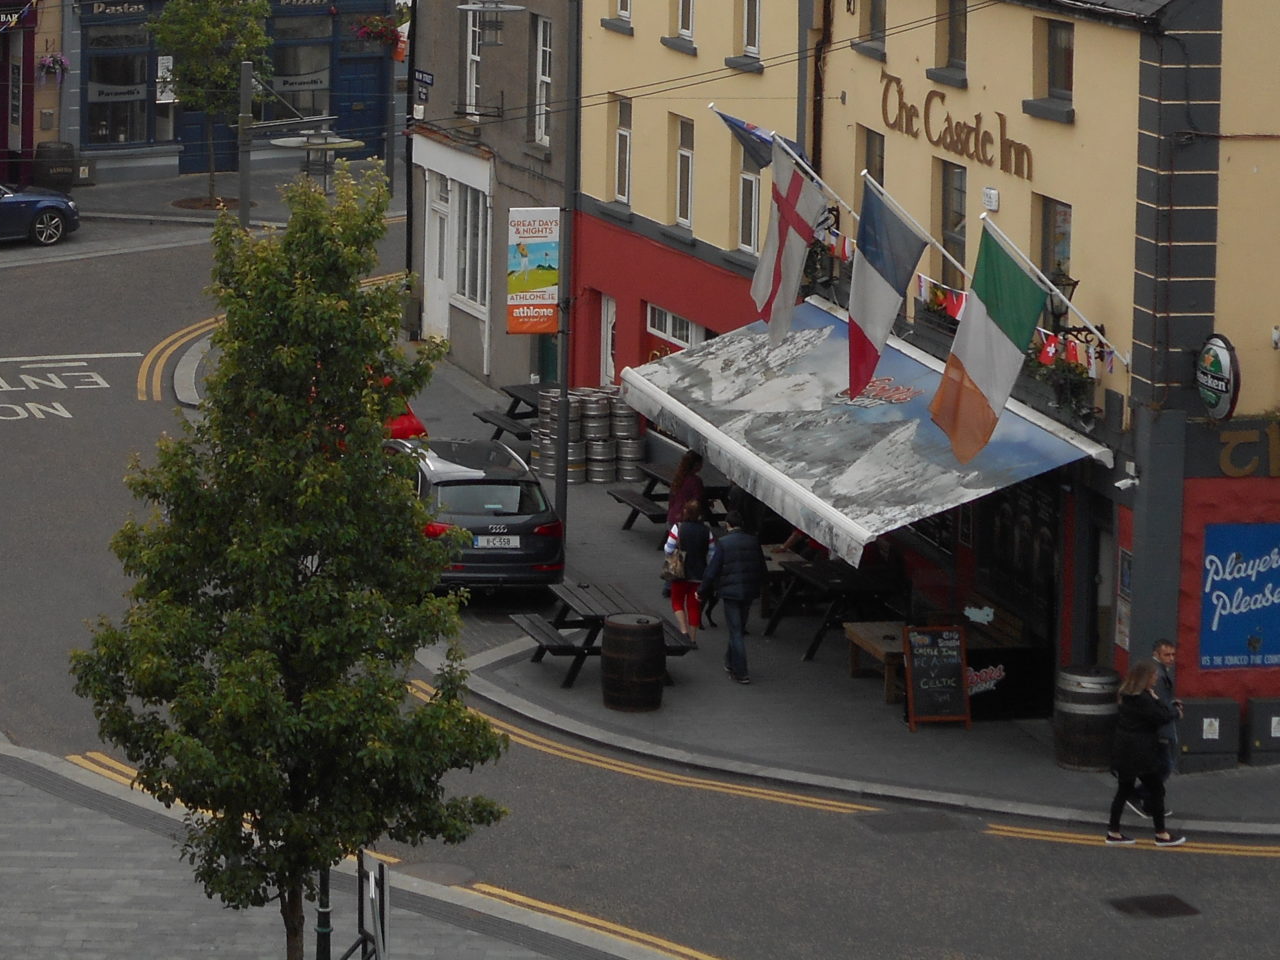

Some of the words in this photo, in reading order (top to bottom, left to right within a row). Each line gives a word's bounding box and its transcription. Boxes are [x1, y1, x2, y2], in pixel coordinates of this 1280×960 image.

[93, 3, 145, 14] Pastas
[0, 14, 19, 22] BAR
[880, 66, 920, 138] The
[924, 90, 995, 167] Castle
[994, 111, 1033, 182] Inn
[510, 220, 536, 228] GREAT
[538, 219, 559, 227] DAYS
[522, 227, 554, 235] NIGHTS
[510, 293, 555, 301] ATHLONE.IE
[513, 306, 554, 317] athlone
[1212, 583, 1280, 631] Please
